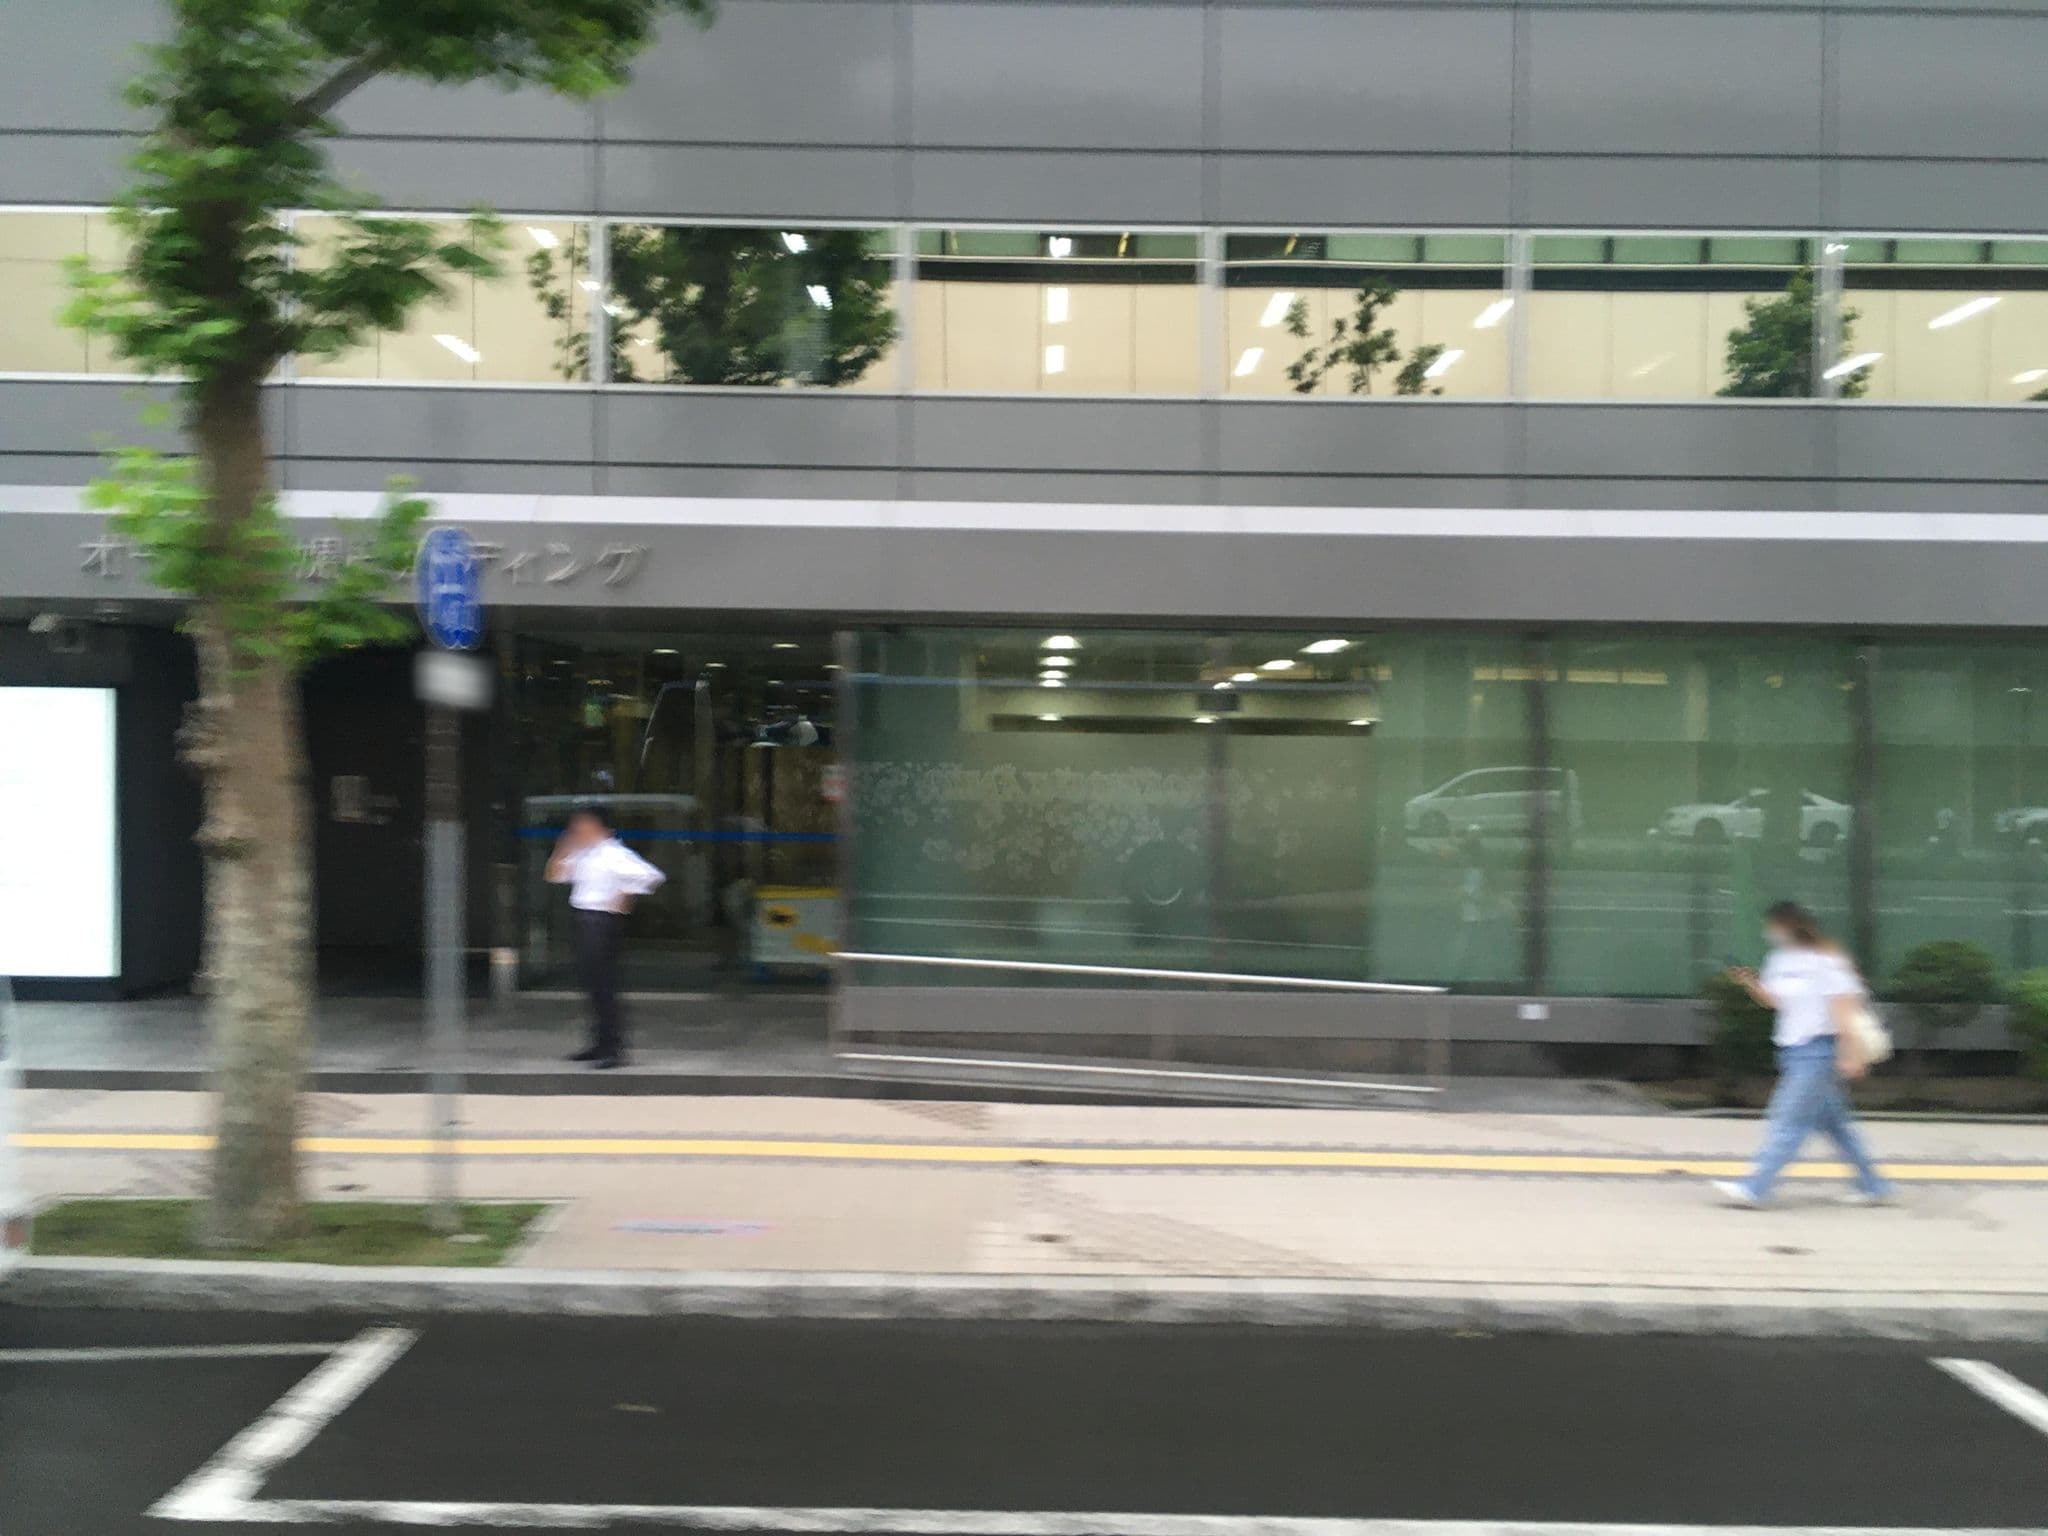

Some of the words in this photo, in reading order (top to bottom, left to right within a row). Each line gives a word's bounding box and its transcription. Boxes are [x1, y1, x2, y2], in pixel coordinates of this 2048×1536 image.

[78, 536, 649, 586] オー幌ディング
